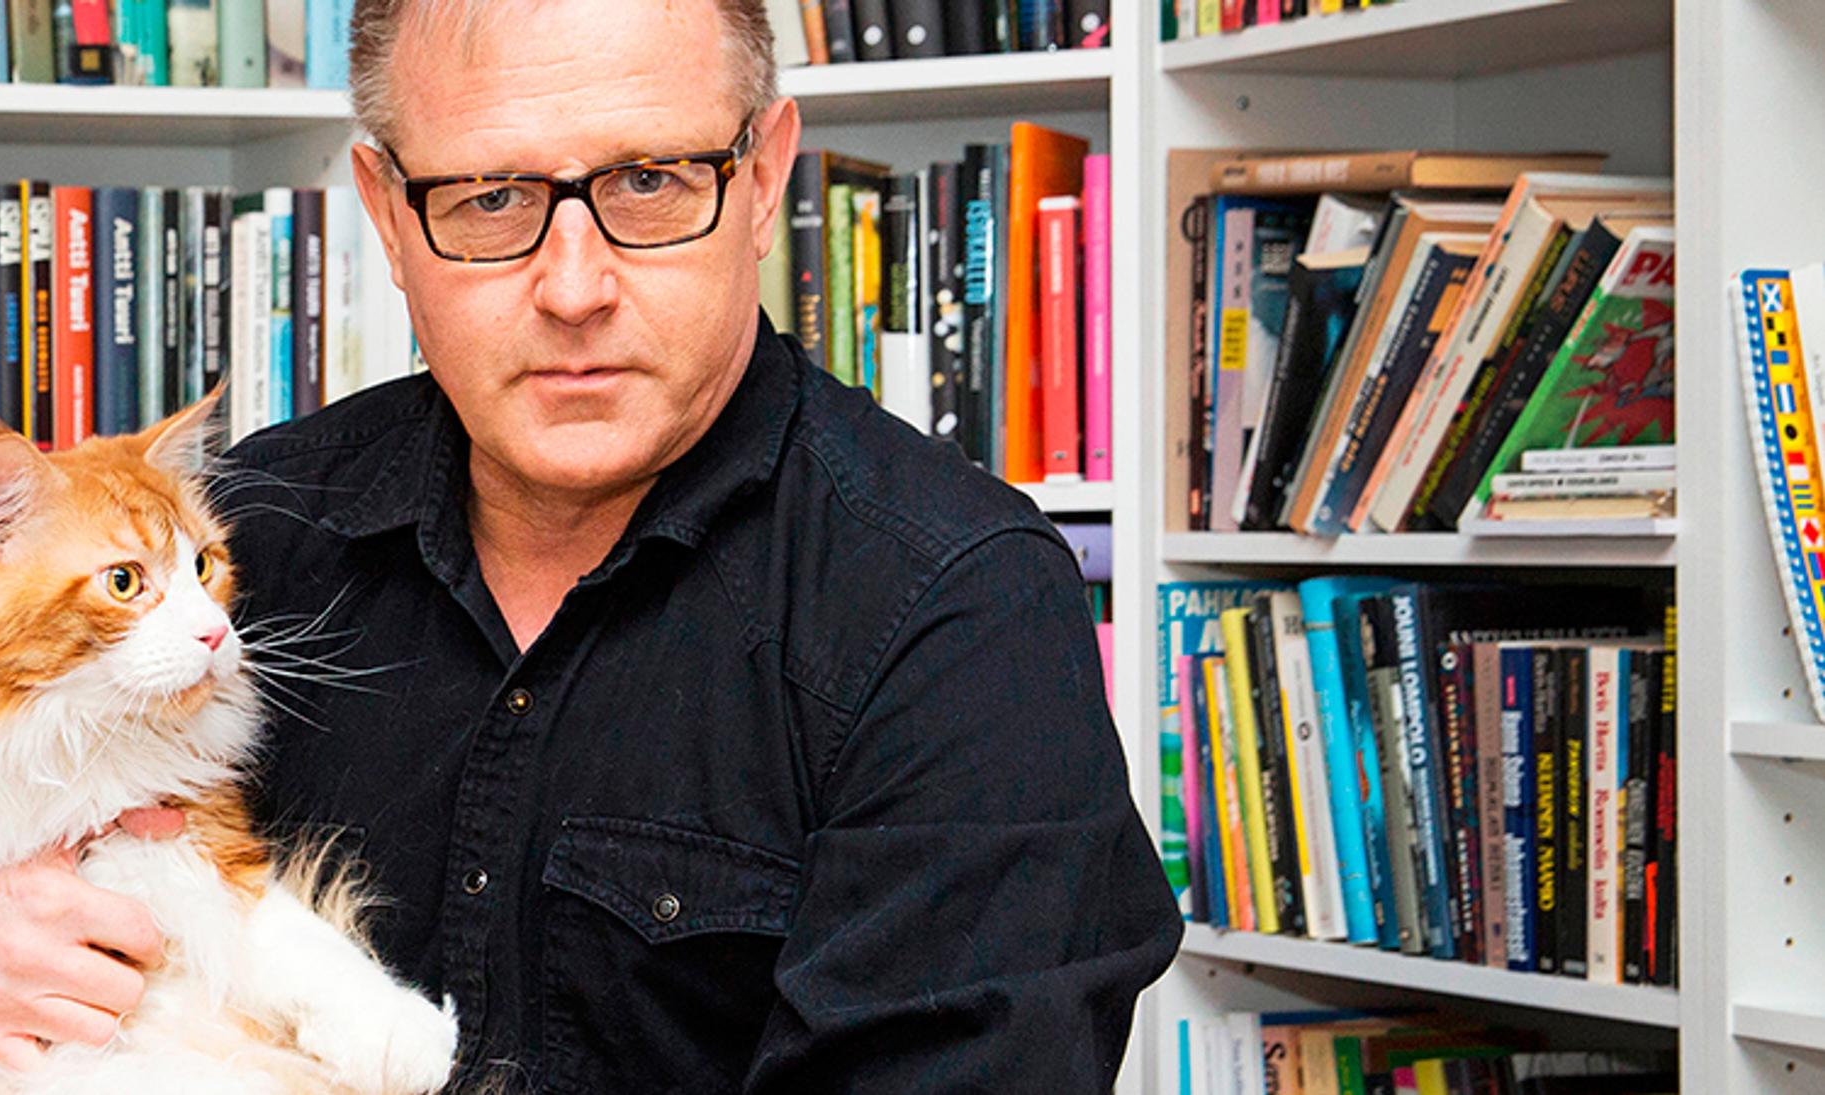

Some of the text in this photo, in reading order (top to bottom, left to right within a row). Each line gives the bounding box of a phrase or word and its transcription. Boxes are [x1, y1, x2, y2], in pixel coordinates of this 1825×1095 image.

[70, 209, 88, 332] Antti Tuuri
[114, 217, 133, 344] Antti Tuuri
[1393, 596, 1428, 765] JOUNI LOMPOLO
[1595, 672, 1611, 772] Boris Hurtta
[1536, 753, 1554, 911] KULTAINEN NAAMIO
[1594, 879, 1610, 919] kulta
